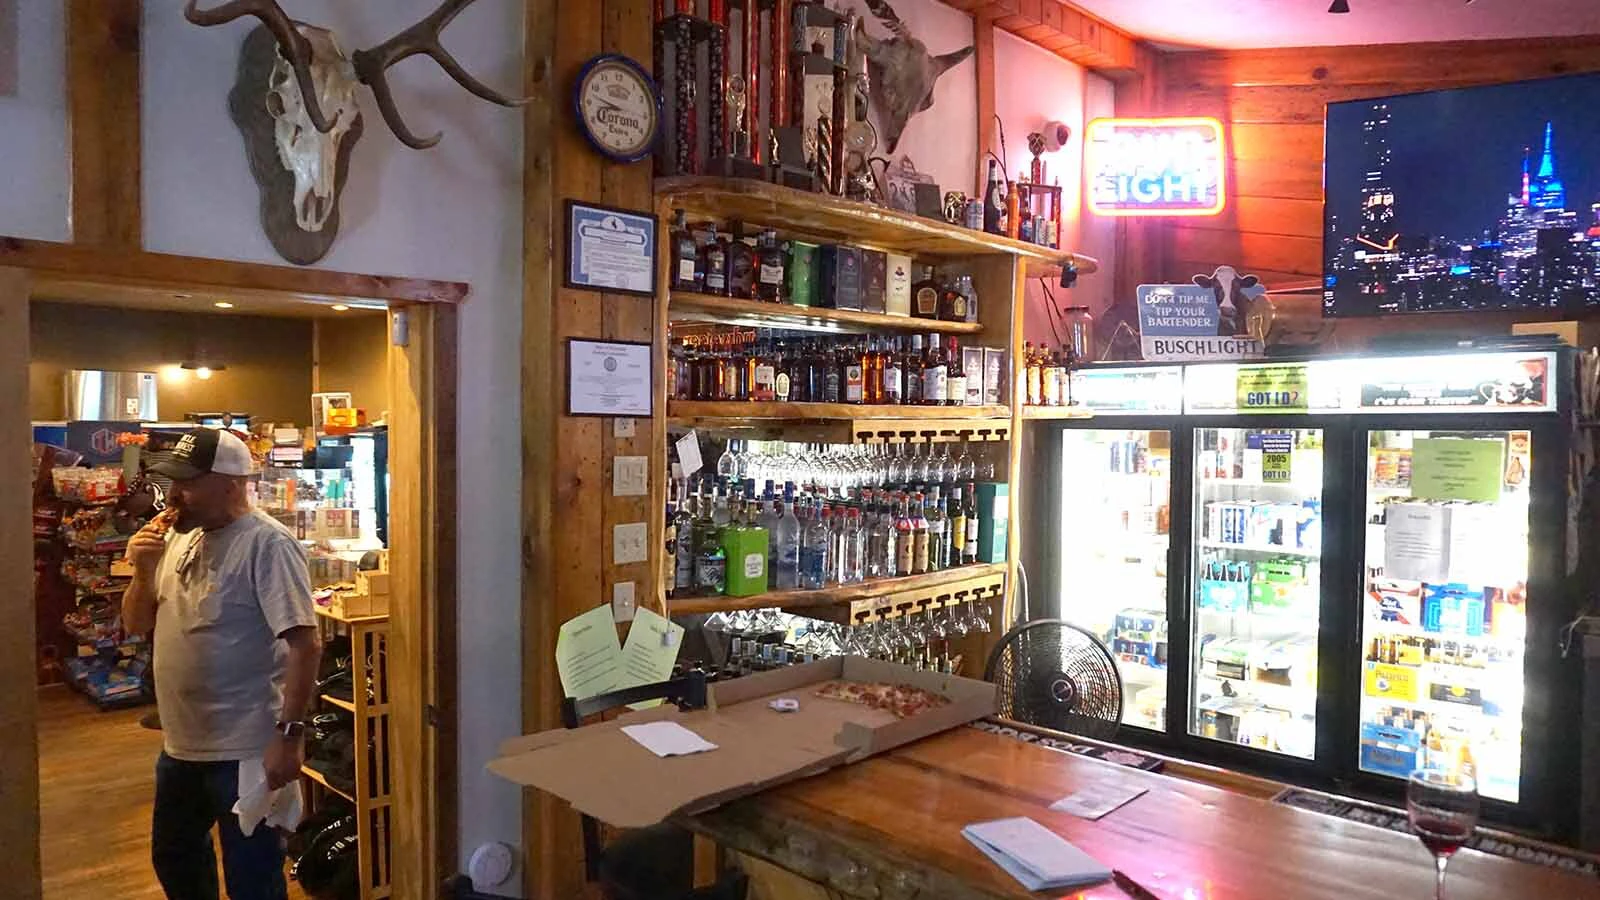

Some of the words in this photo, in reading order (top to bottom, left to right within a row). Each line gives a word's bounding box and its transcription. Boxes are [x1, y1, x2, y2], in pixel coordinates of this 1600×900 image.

[597, 106, 640, 128] Corona
[1178, 295, 1193, 304] TIP
[1156, 306, 1172, 317] TIP
[1175, 306, 1206, 317] YOUR
[1247, 391, 1272, 405] GOT
[1266, 454, 1287, 463] 2005
